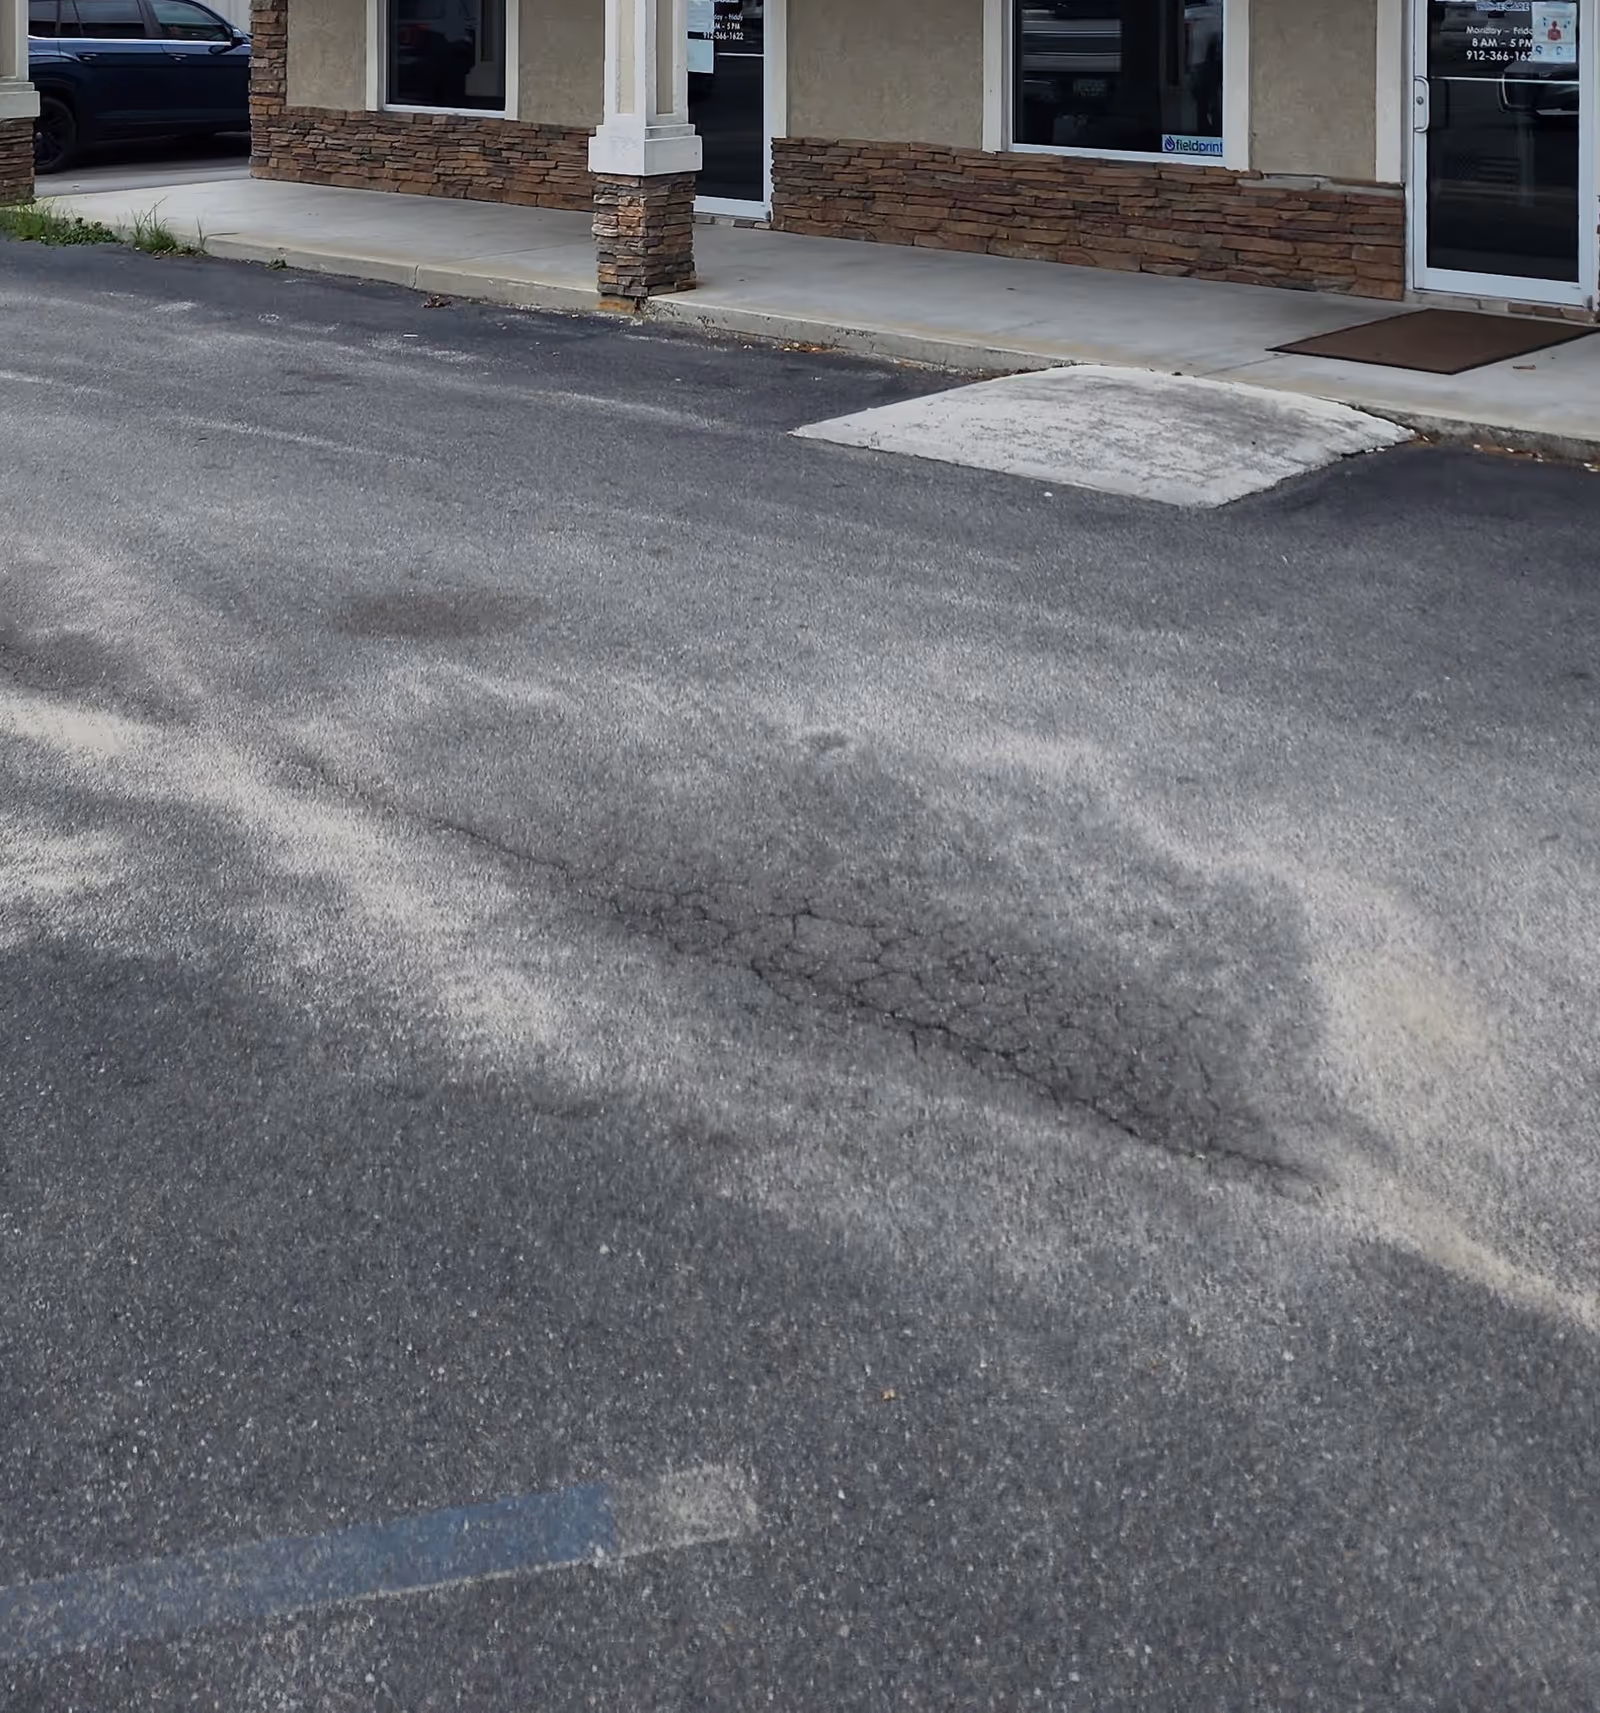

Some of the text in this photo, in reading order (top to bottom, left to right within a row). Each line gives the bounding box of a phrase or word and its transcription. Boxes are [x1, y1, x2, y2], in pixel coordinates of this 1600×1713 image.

[1465, 26, 1502, 36] Monday
[1472, 38, 1478, 47] 8
[1480, 38, 1498, 47] AM
[1509, 38, 1516, 48] 5
[1466, 50, 1533, 62] 912-366-162
[1176, 139, 1222, 153] fieldprint
